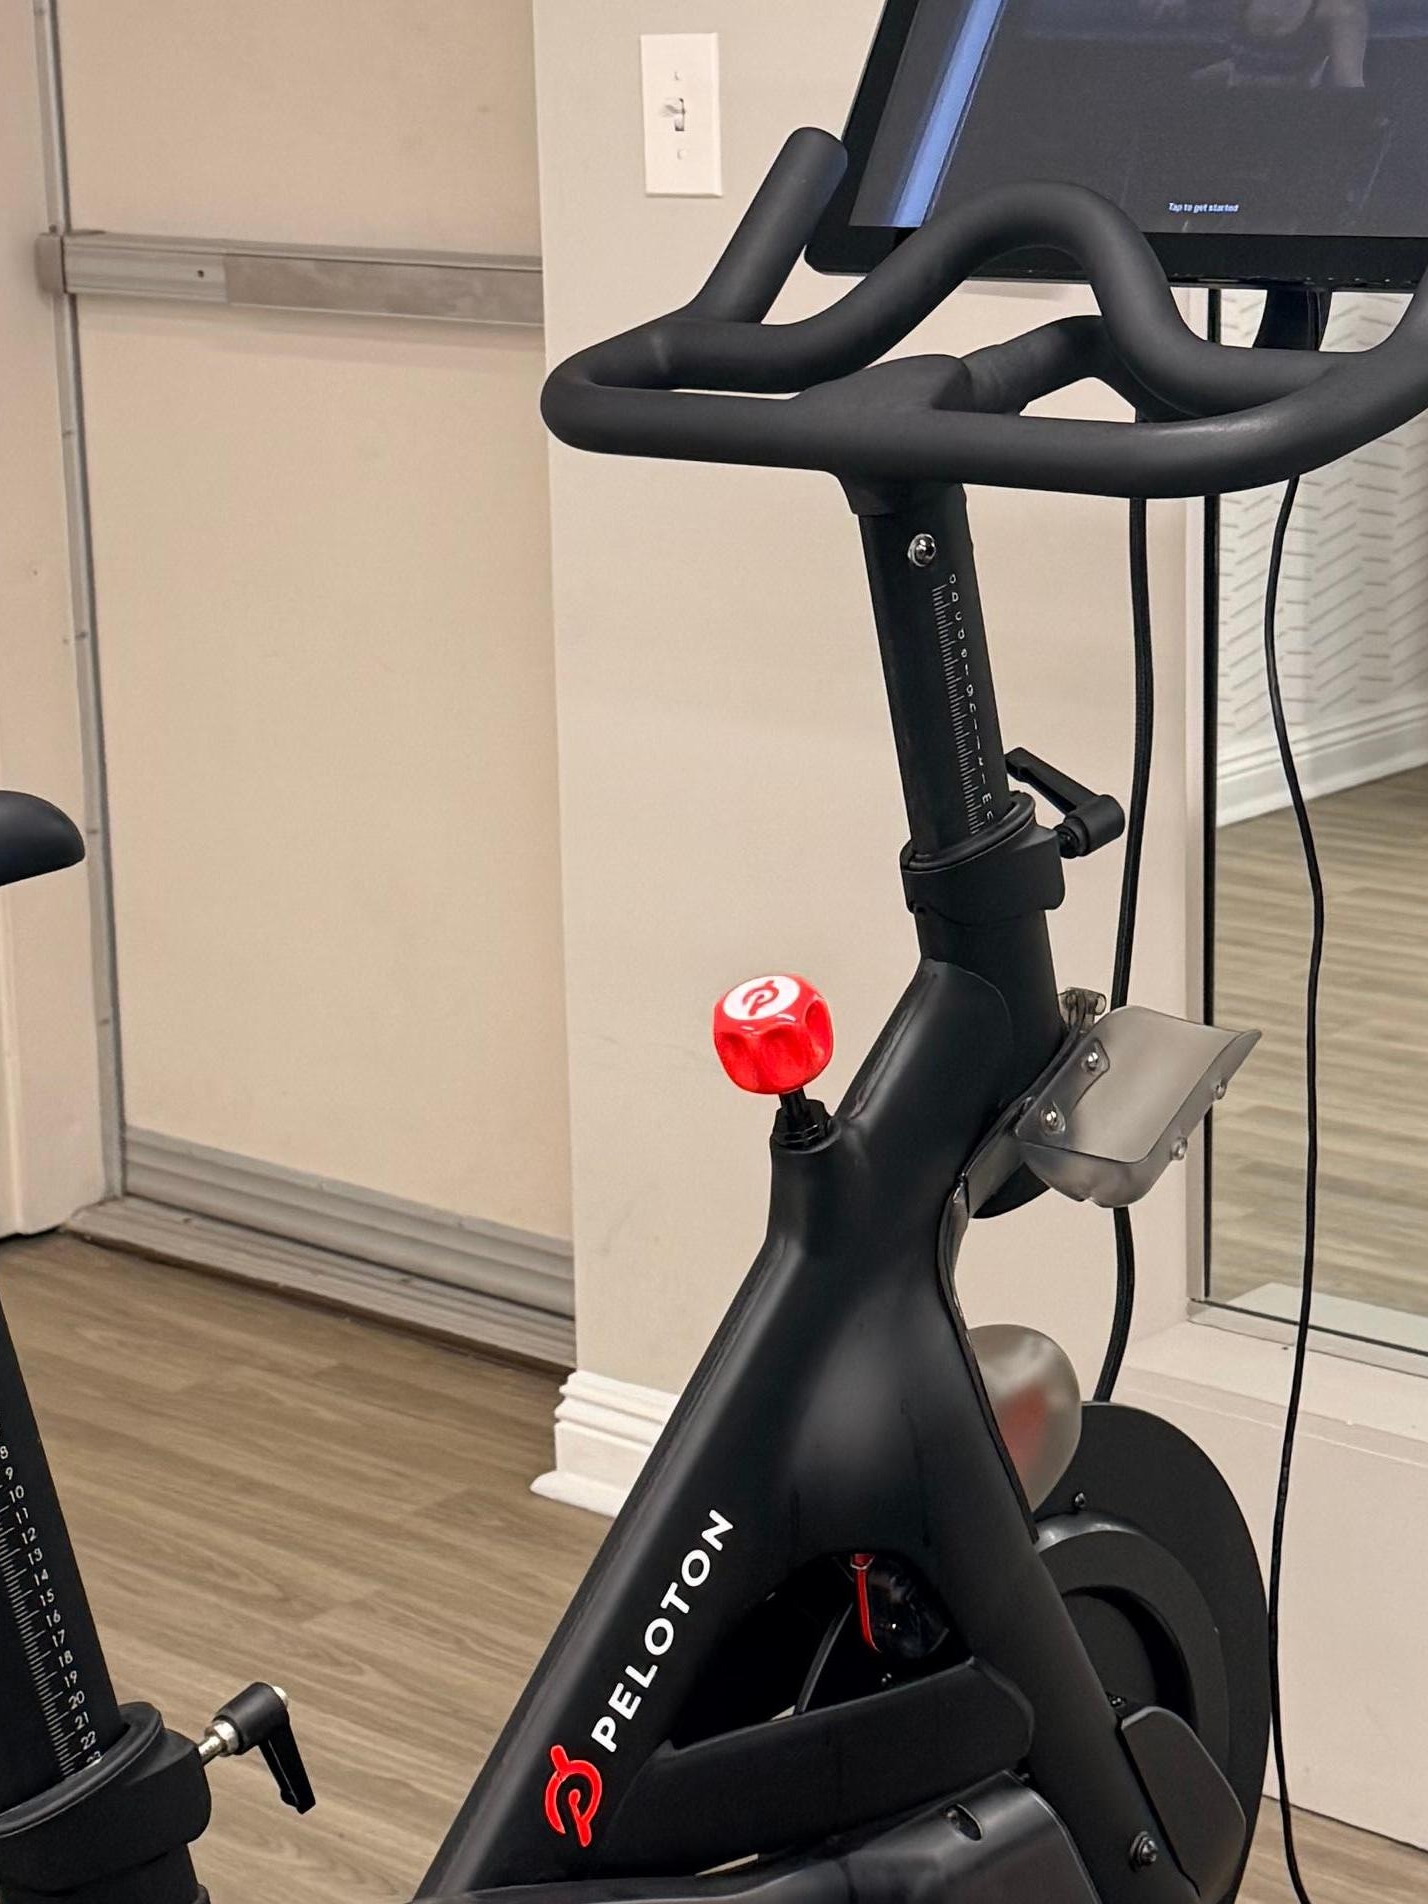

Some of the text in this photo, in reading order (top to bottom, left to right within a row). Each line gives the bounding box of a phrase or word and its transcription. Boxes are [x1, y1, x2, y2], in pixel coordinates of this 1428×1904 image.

[1168, 202, 1239, 214] Tap to get started
[0, 1445, 9, 1460] 8
[5, 1466, 14, 1481] 9
[9, 1485, 25, 1503] 10
[15, 1507, 29, 1525] 11
[21, 1527, 37, 1545] 12
[28, 1547, 43, 1565] 13
[34, 1568, 49, 1586] 14
[40, 1588, 55, 1606] 15
[46, 1609, 61, 1627] 16
[52, 1629, 65, 1647] 17
[590, 1509, 734, 1753] PELOTON
[58, 1649, 73, 1668] 18
[64, 1670, 77, 1688] 19
[68, 1690, 85, 1710] 20
[75, 1711, 89, 1730] 21
[80, 1730, 96, 1750] 22
